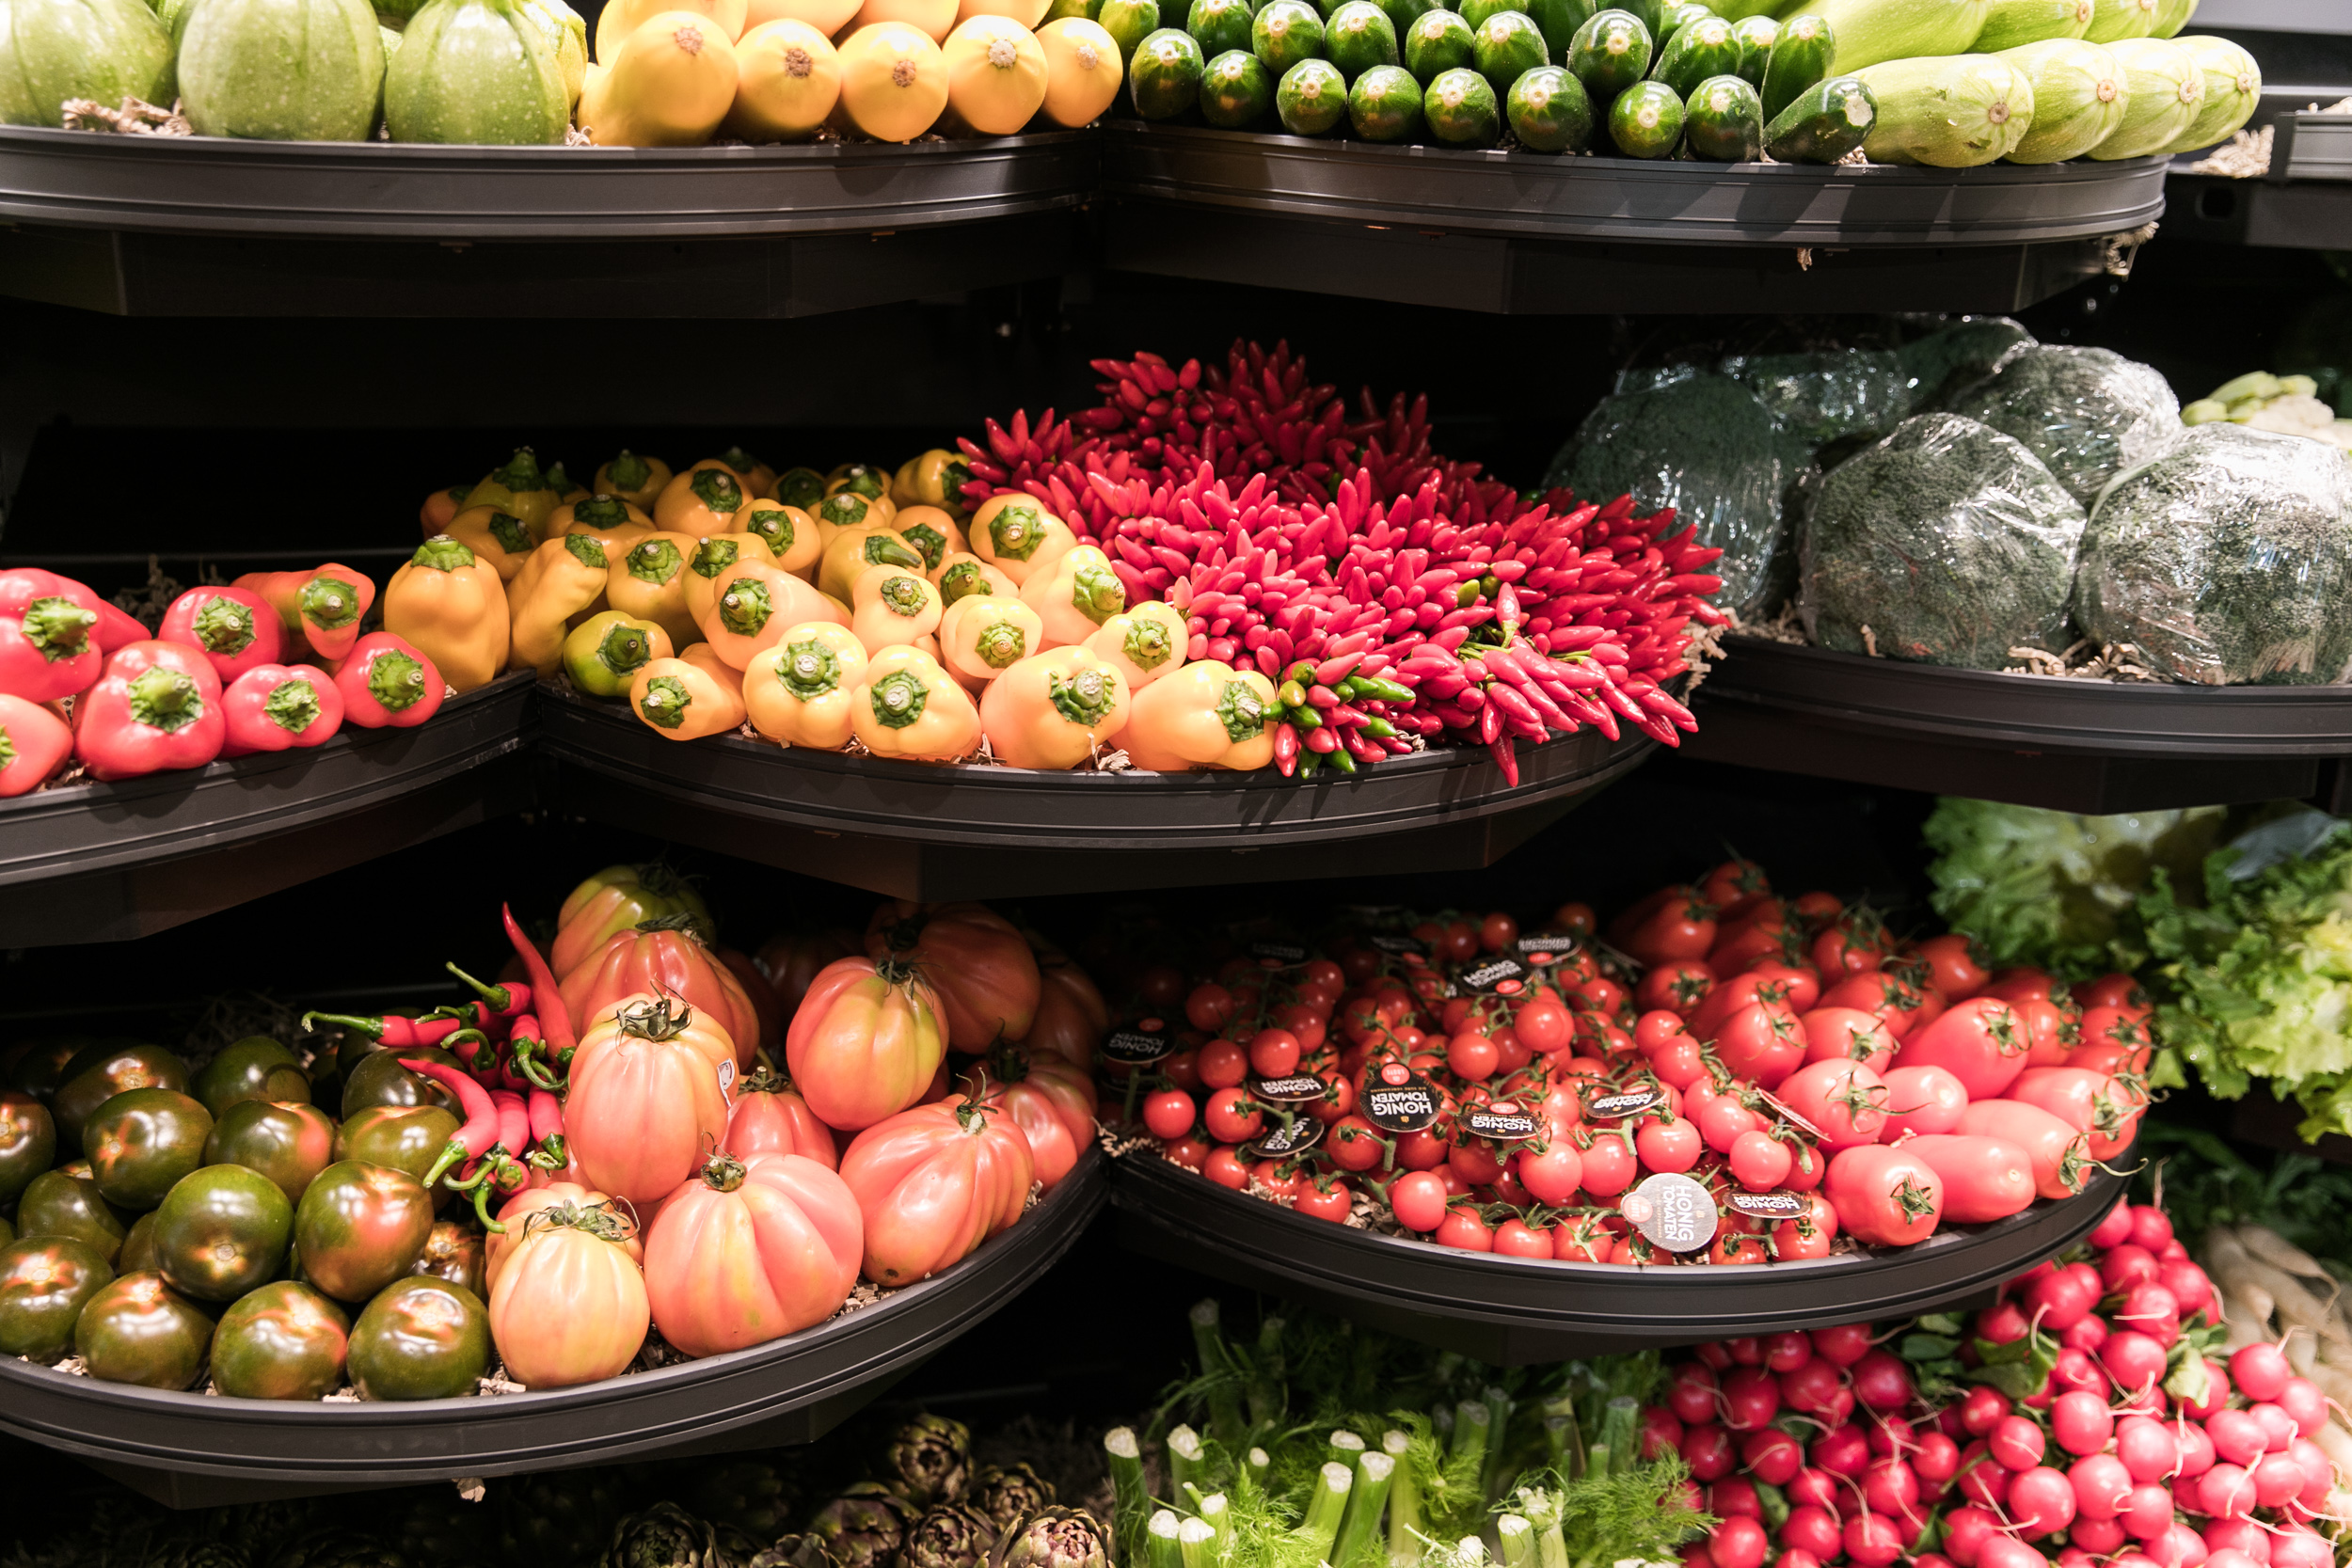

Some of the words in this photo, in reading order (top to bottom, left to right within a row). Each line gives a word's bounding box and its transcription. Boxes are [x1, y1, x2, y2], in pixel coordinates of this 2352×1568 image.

[1108, 1038, 1164, 1055] HONIG
[1261, 1078, 1316, 1089] TOMATEN
[1265, 1082, 1322, 1094] HONIG
[1371, 1091, 1430, 1104] TOMATEN
[1373, 1101, 1433, 1117] HONIG
[1471, 1115, 1533, 1124] TOMATEN
[1471, 1120, 1534, 1132] HONIG
[1737, 1201, 1801, 1210] HONIG
[1662, 1185, 1678, 1240] TOMATEN
[1676, 1185, 1694, 1242] HONIG
